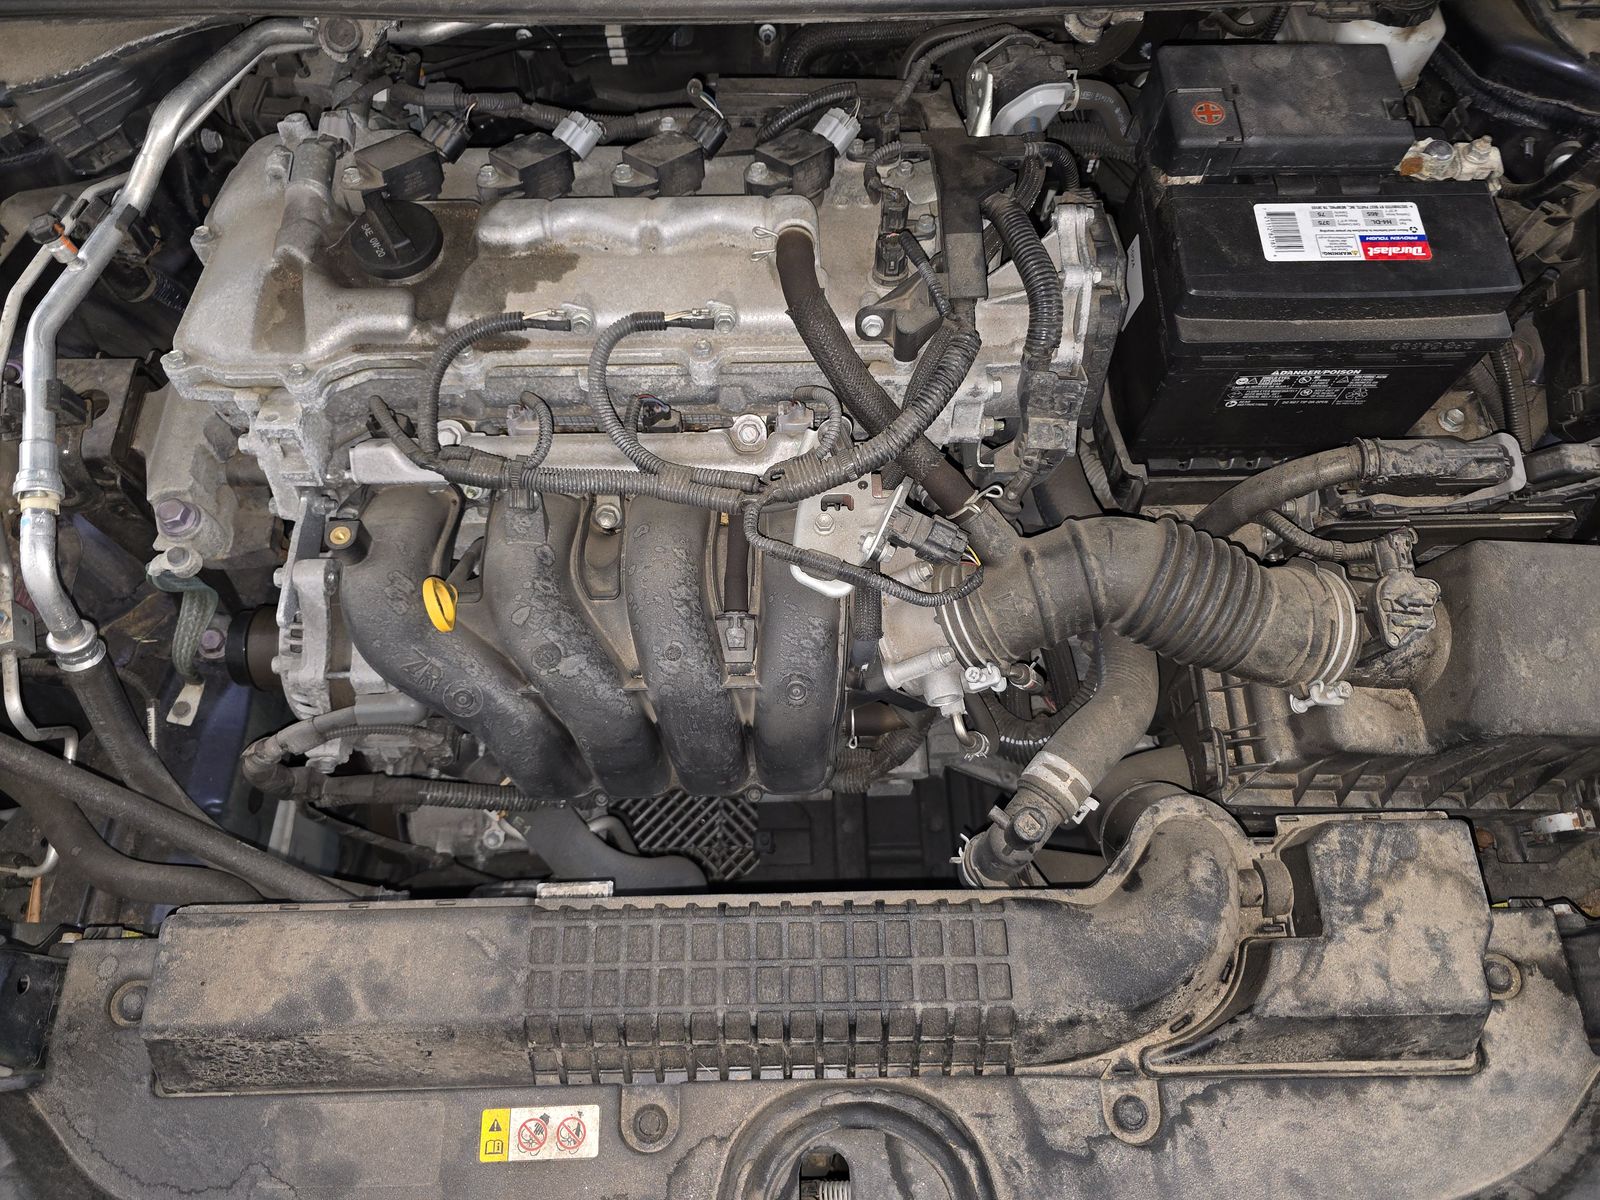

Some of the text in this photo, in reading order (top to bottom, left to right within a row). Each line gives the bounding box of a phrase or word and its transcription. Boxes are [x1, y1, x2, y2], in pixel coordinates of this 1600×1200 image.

[361, 224, 386, 258] SAE 0W-20
[1368, 246, 1426, 256] Duralast
